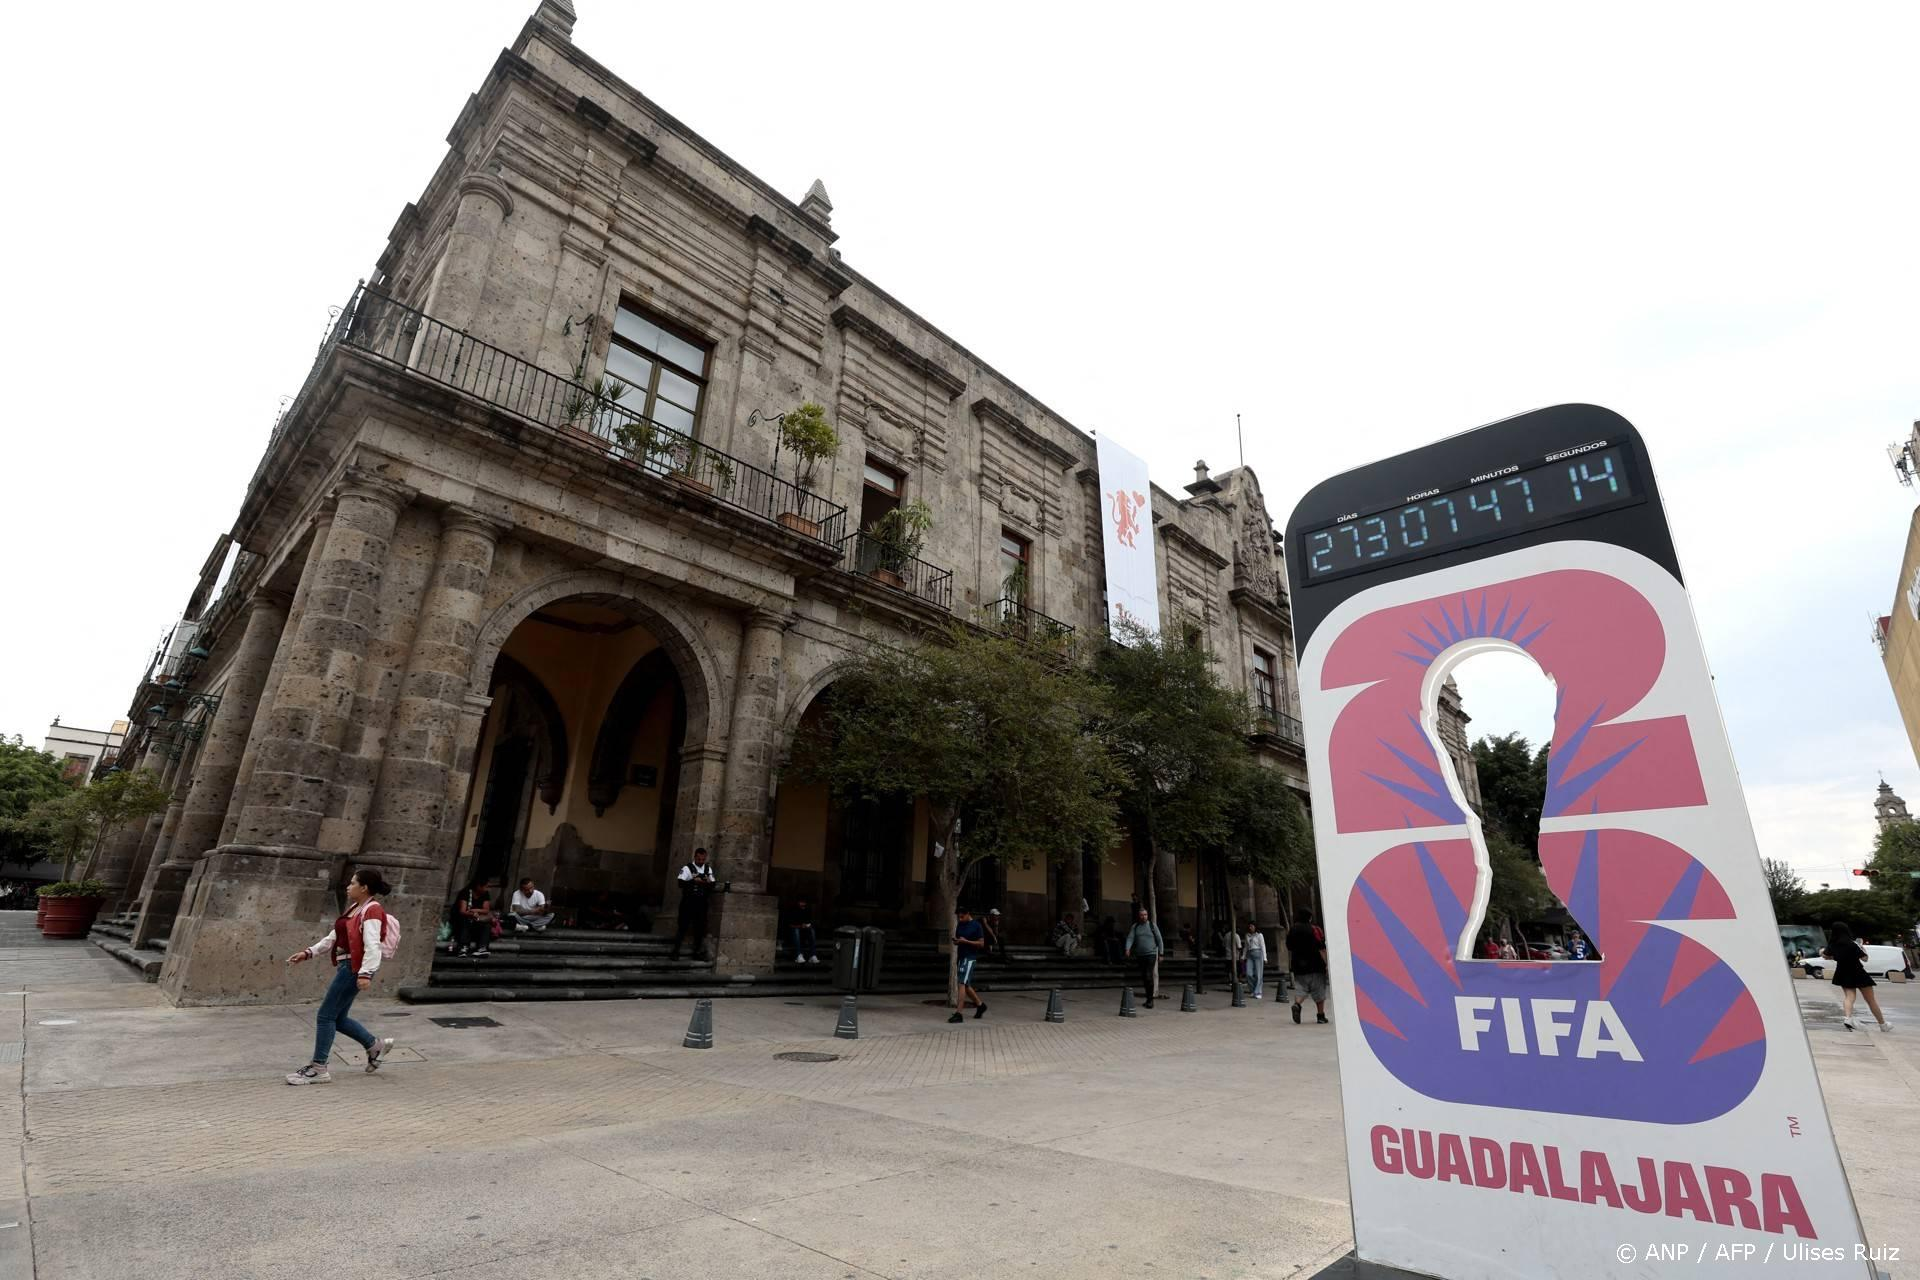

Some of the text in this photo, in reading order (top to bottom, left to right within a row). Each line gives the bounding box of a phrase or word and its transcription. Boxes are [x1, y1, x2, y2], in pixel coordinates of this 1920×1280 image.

[1545, 440, 1608, 463] SEGUNDOS
[1470, 465, 1519, 484] MINUTOS
[1406, 488, 1440, 502] HORAS
[1311, 456, 1618, 572] 273 07 47 14
[1336, 511, 1359, 524] DÍAS
[1454, 995, 1645, 1062] FIFA
[1370, 1124, 1819, 1240] GUADALAJARA
